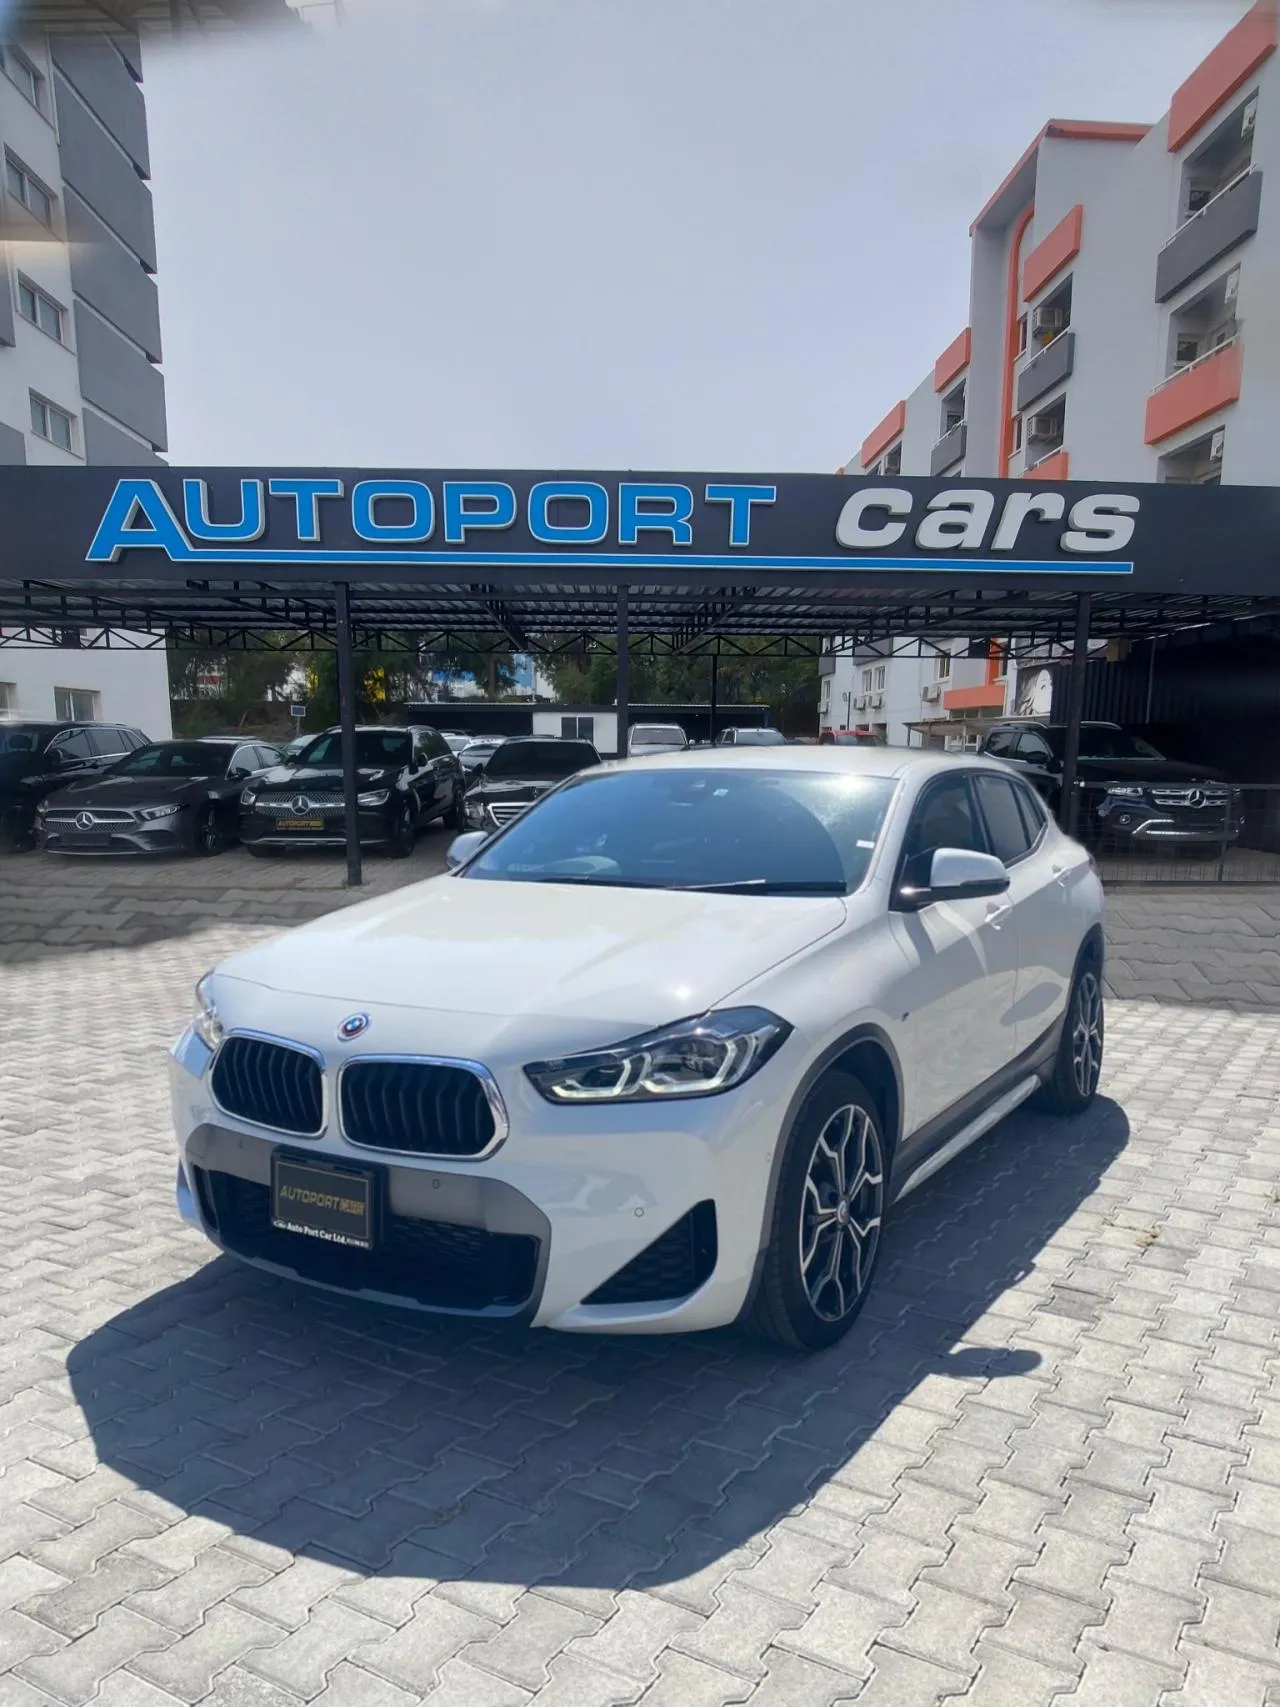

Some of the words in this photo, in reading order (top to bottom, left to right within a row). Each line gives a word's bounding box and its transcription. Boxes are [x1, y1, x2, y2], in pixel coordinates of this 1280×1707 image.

[85, 478, 778, 563] AUTOPORT
[836, 487, 1141, 554] cars
[280, 1185, 340, 1210] AUTOPORT
[286, 1222, 303, 1233] Auto
[303, 1225, 319, 1238] Port
[319, 1230, 332, 1241] Car
